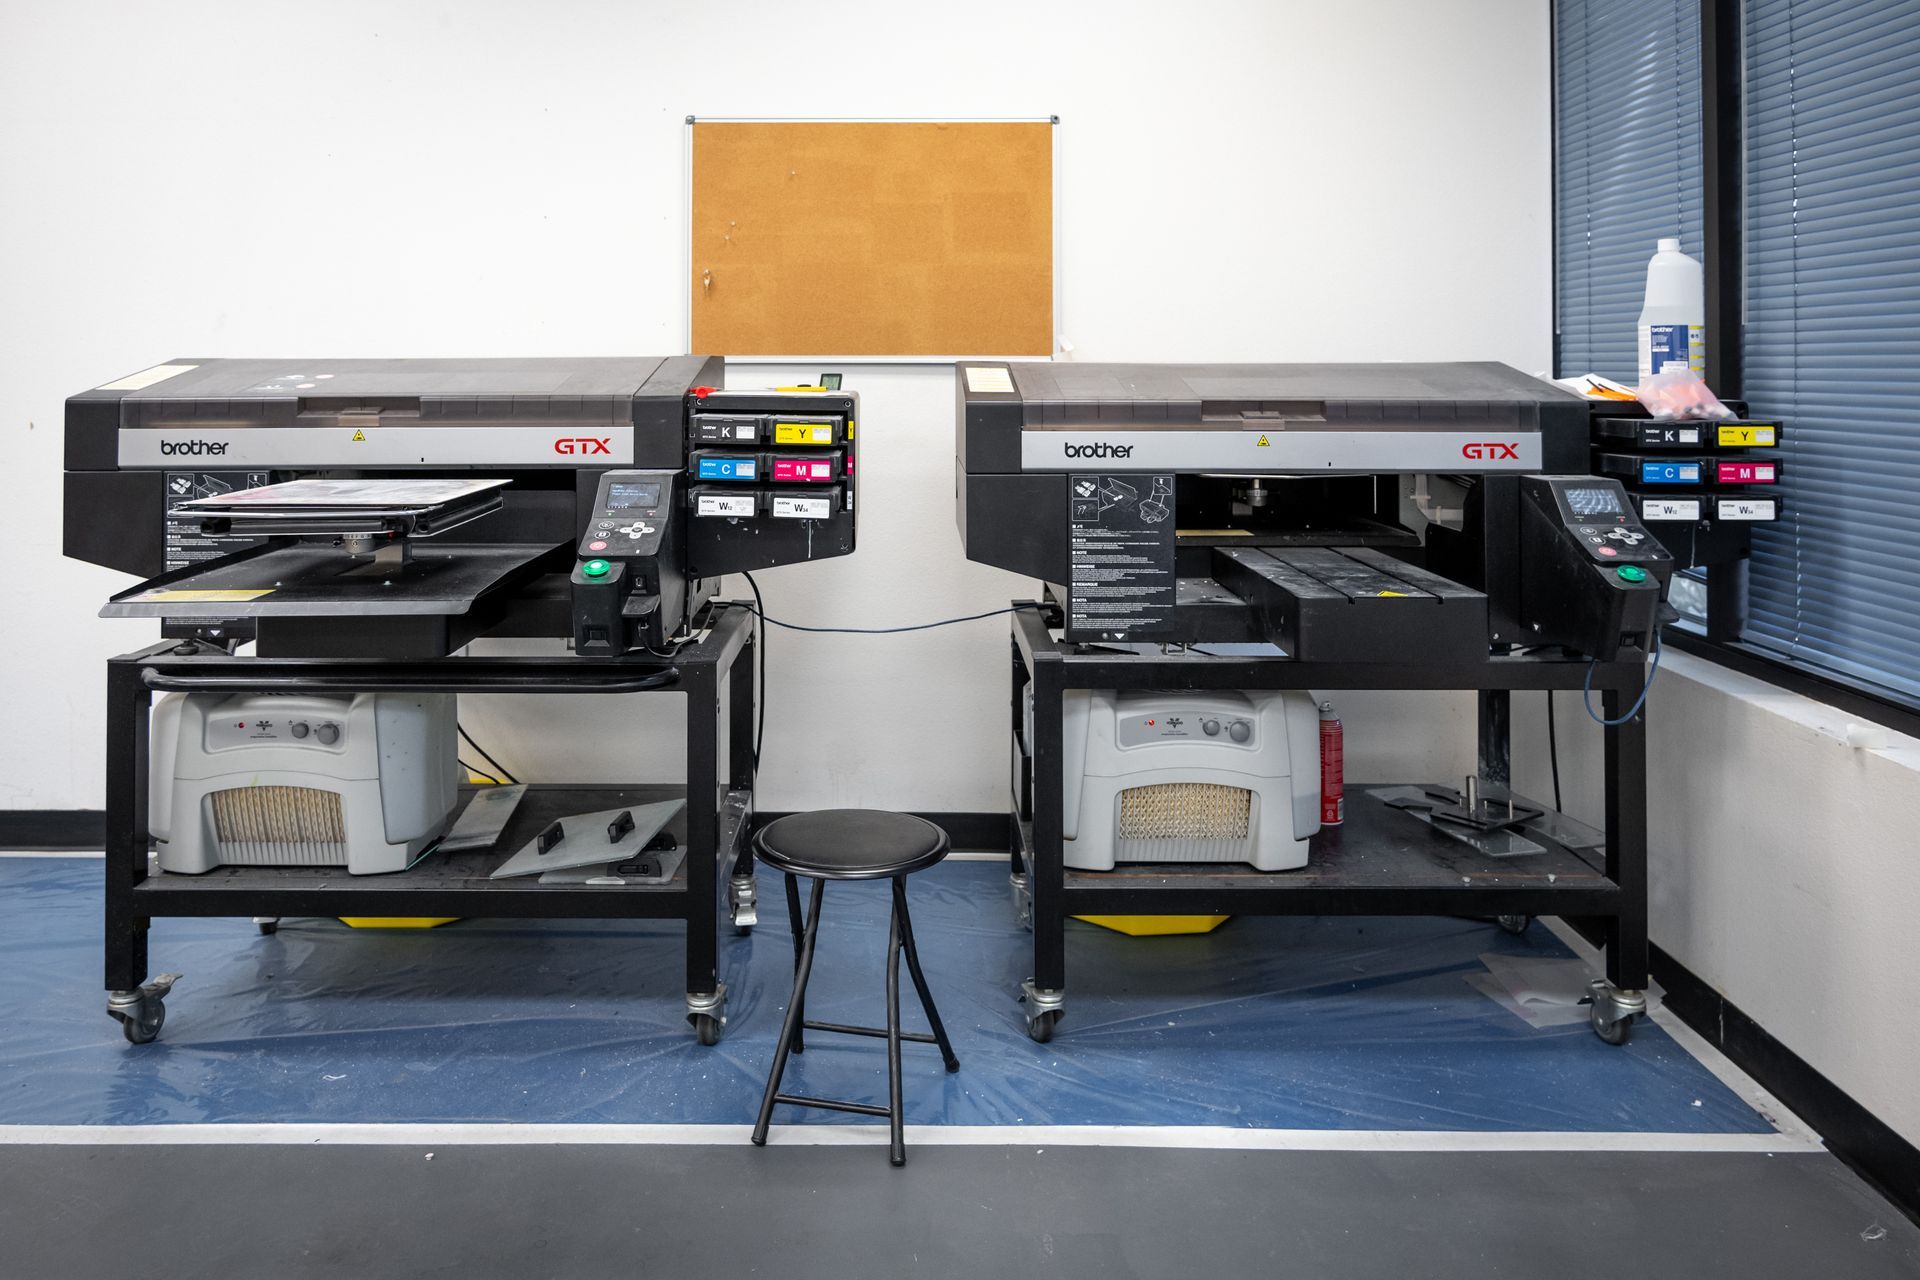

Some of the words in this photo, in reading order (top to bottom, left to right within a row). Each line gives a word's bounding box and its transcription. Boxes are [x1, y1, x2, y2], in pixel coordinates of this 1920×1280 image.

[721, 427, 731, 438] K
[799, 429, 807, 439] Y
[1664, 430, 1674, 441] K
[1741, 431, 1749, 441] Y
[161, 439, 229, 455] brother
[554, 438, 611, 454] GTX
[1064, 442, 1134, 458] brother
[1462, 442, 1519, 459] GTX
[721, 464, 731, 475] C
[796, 465, 806, 476] M
[1664, 467, 1674, 478] C
[1740, 468, 1750, 479] M
